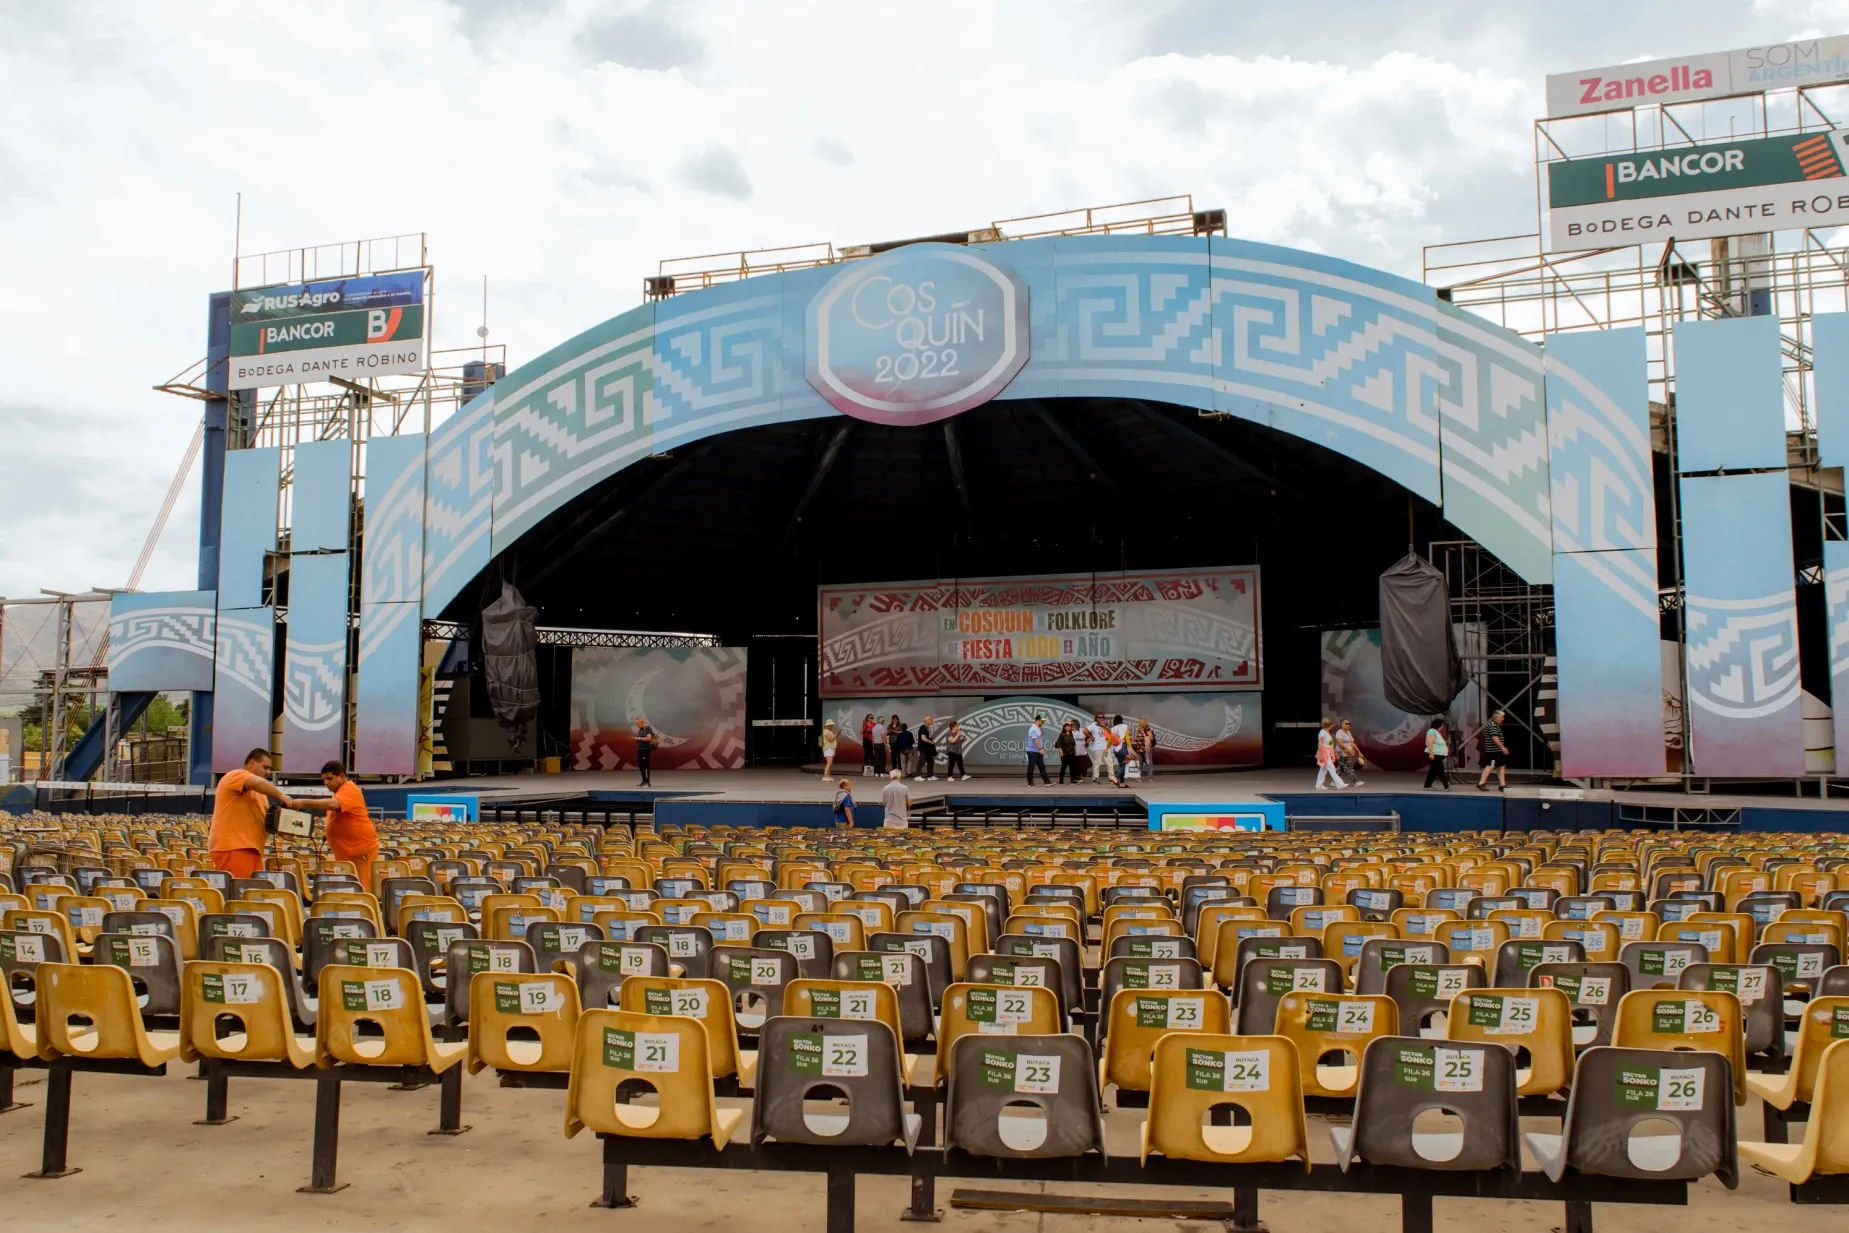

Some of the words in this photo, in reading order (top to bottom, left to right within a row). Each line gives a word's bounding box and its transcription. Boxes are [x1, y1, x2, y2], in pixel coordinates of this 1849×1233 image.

[1579, 65, 1713, 104] Zanella
[1618, 150, 1744, 183] BANCOR
[1688, 203, 1775, 224] DANTE
[267, 322, 334, 343] BANCOR
[302, 359, 348, 372] DANTE
[357, 353, 416, 367] ROBINO
[875, 349, 960, 382] 2022
[944, 618, 955, 630] EN
[1048, 610, 1115, 630] FOLKLORE
[962, 638, 1012, 660] FIESTA
[1016, 636, 1061, 659] TODO
[1064, 640, 1073, 653] EL
[1077, 632, 1110, 657] AÑO
[866, 914, 876, 922] 19
[732, 926, 743, 936] 18
[1525, 923, 1537, 931] 26
[833, 928, 845, 938] 19
[566, 936, 579, 945] 17
[676, 941, 688, 950] 18
[1477, 936, 1490, 944] 25
[1589, 937, 1602, 946] 26
[1705, 936, 1717, 947] 27
[21, 946, 36, 956] 14
[136, 946, 151, 956] 15
[794, 943, 807, 952] 19
[248, 953, 262, 963] 16
[374, 952, 390, 962] 17
[497, 957, 512, 968] 18
[628, 956, 643, 967] 19
[1410, 955, 1427, 964] 24
[891, 963, 904, 973] 21
[1670, 959, 1686, 968] 26
[1803, 961, 1817, 970] 27
[757, 966, 775, 978] 20
[1021, 975, 1038, 985] 22
[1155, 974, 1173, 984] 23
[1299, 977, 1318, 988] 24
[1445, 978, 1461, 989] 25
[1744, 977, 1761, 988] 27
[231, 983, 248, 996] 17
[1586, 985, 1604, 997] 26
[373, 989, 392, 1002] 18
[528, 991, 546, 1005] 19
[814, 995, 839, 1003] SONKO
[679, 998, 700, 1011] 20
[851, 1000, 867, 1013] 21
[1004, 1000, 1025, 1012] 22
[1473, 1001, 1500, 1009] SONKO
[1175, 1007, 1197, 1021] 23
[1344, 1011, 1368, 1024] 24
[1509, 1007, 1531, 1021] 25
[1692, 1011, 1714, 1024] 26
[608, 1038, 633, 1048] SONKO
[794, 1044, 821, 1052] SONKO
[646, 1046, 666, 1061] 21
[832, 1050, 856, 1065] 22
[985, 1058, 1014, 1069] SONKO
[1192, 1059, 1223, 1068] SONKO
[1401, 1055, 1433, 1065] SONKO
[988, 1070, 1002, 1078] FILA
[1025, 1067, 1050, 1082] 23
[1233, 1064, 1261, 1080] 24
[1445, 1062, 1471, 1077] 25
[1623, 1077, 1657, 1085] SONKO
[1668, 1081, 1696, 1097] 26
